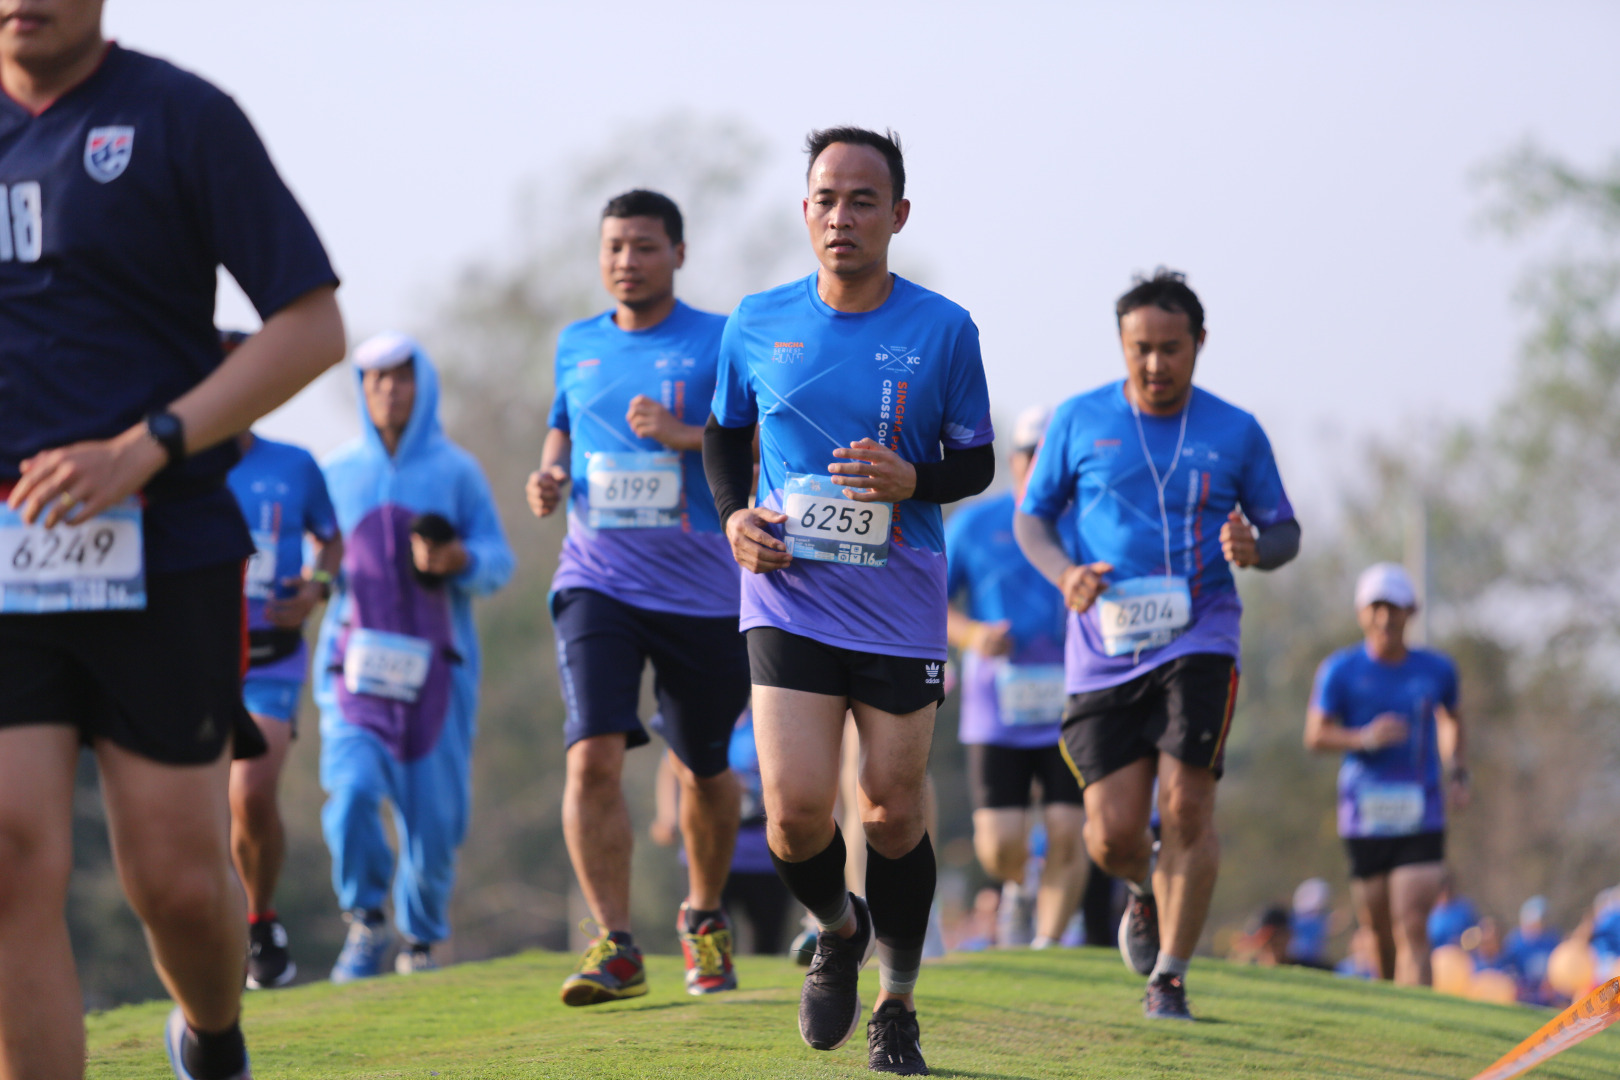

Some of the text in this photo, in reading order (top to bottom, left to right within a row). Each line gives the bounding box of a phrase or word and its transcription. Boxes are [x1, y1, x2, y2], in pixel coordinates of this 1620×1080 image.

[875, 353, 921, 365] SP XC
[878, 379, 892, 446] CROSS COU
[893, 381, 908, 432] SINGHA
[890, 436, 900, 452] PA
[605, 477, 660, 501] 6199
[801, 503, 873, 535] 6253
[892, 503, 901, 522] NG
[12, 528, 115, 572] 6249
[1116, 600, 1173, 628] 6204
